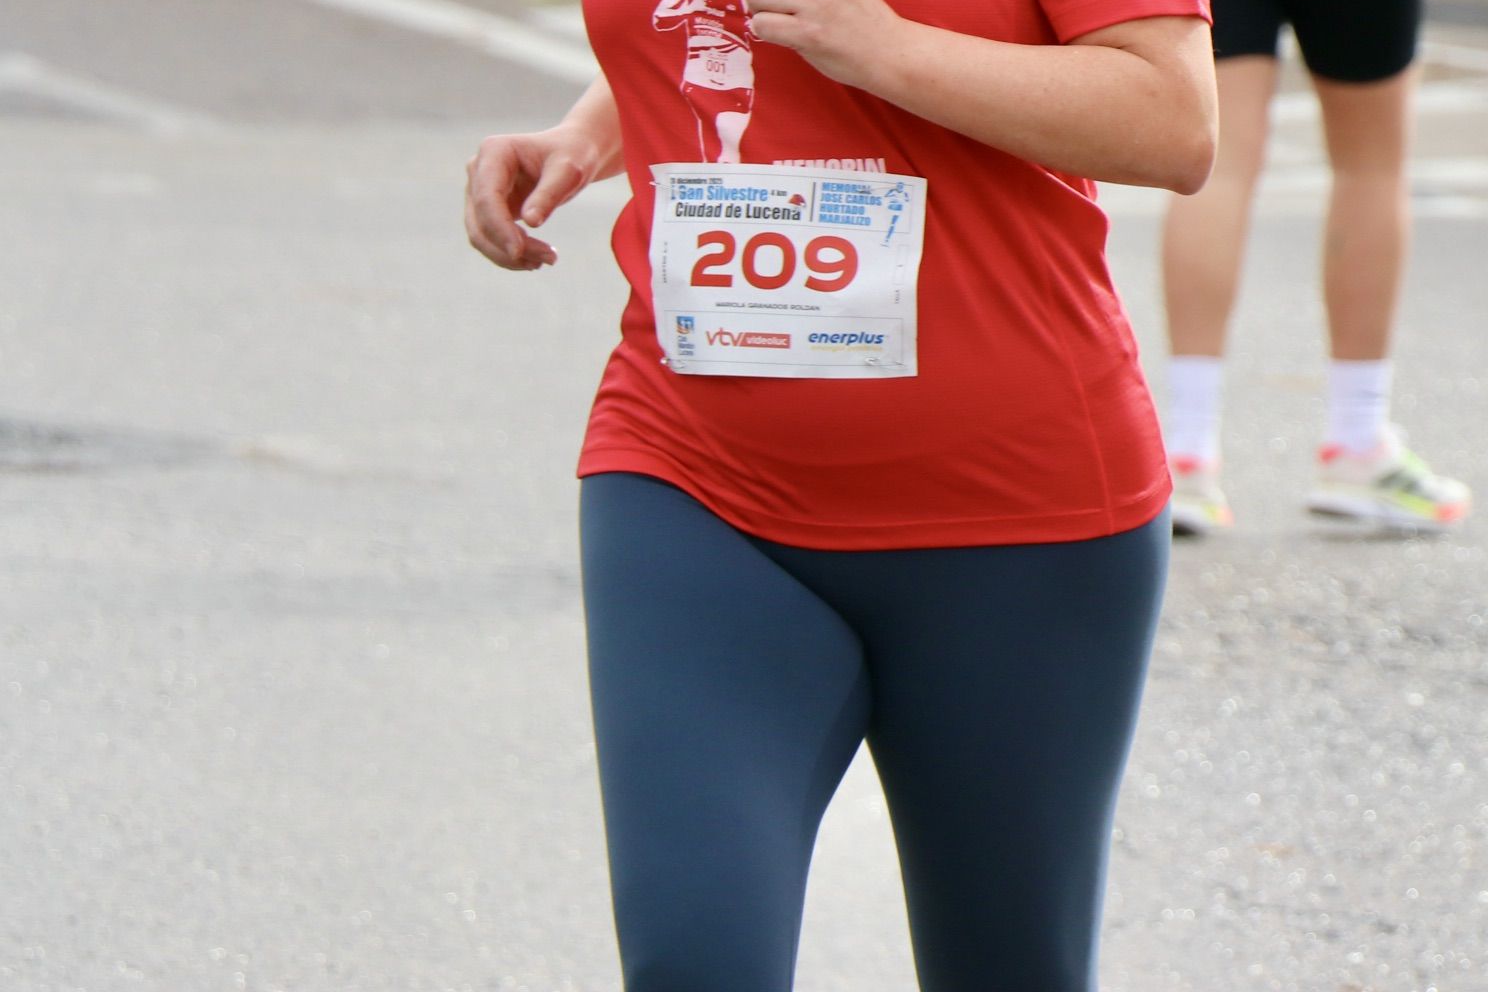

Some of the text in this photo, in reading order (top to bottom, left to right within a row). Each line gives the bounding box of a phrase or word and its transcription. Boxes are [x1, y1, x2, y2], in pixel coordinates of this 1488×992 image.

[706, 59, 726, 74] 001
[679, 185, 704, 200] San
[707, 186, 768, 202] Silvestre
[820, 193, 882, 207] JOSE CARLOS
[675, 202, 801, 221] Ciudad de Lucena
[819, 204, 865, 216] HURTADO
[690, 230, 859, 293] 209
[706, 327, 742, 347] vtv
[746, 336, 788, 347] videoluc
[808, 331, 885, 346] enerplus
